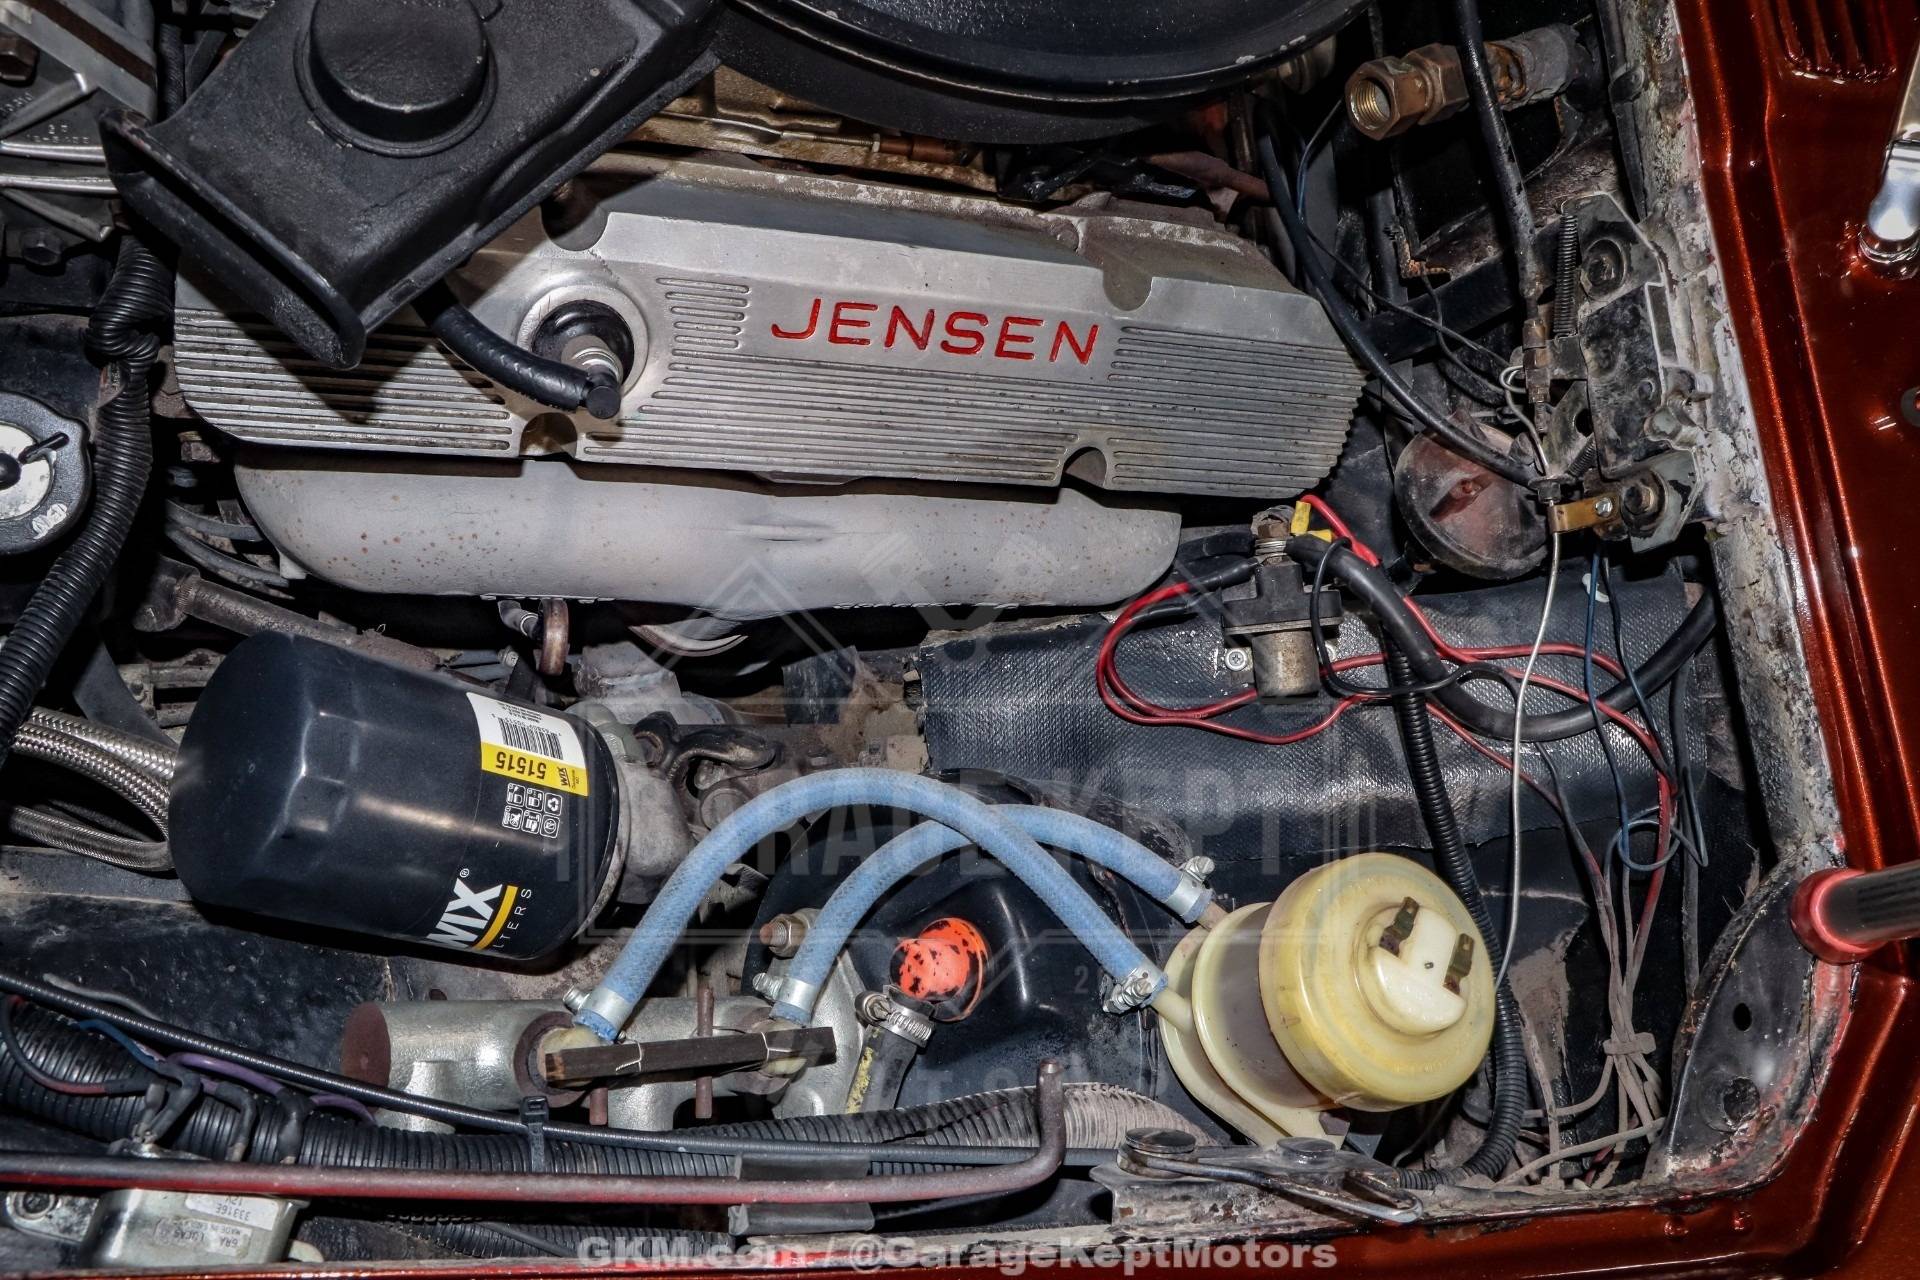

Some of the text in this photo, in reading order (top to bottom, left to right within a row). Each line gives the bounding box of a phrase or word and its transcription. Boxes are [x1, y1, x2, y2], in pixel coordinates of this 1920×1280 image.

[771, 298, 1100, 365] JENSEN
[495, 751, 547, 780] 51515
[492, 888, 532, 949] LTERS
